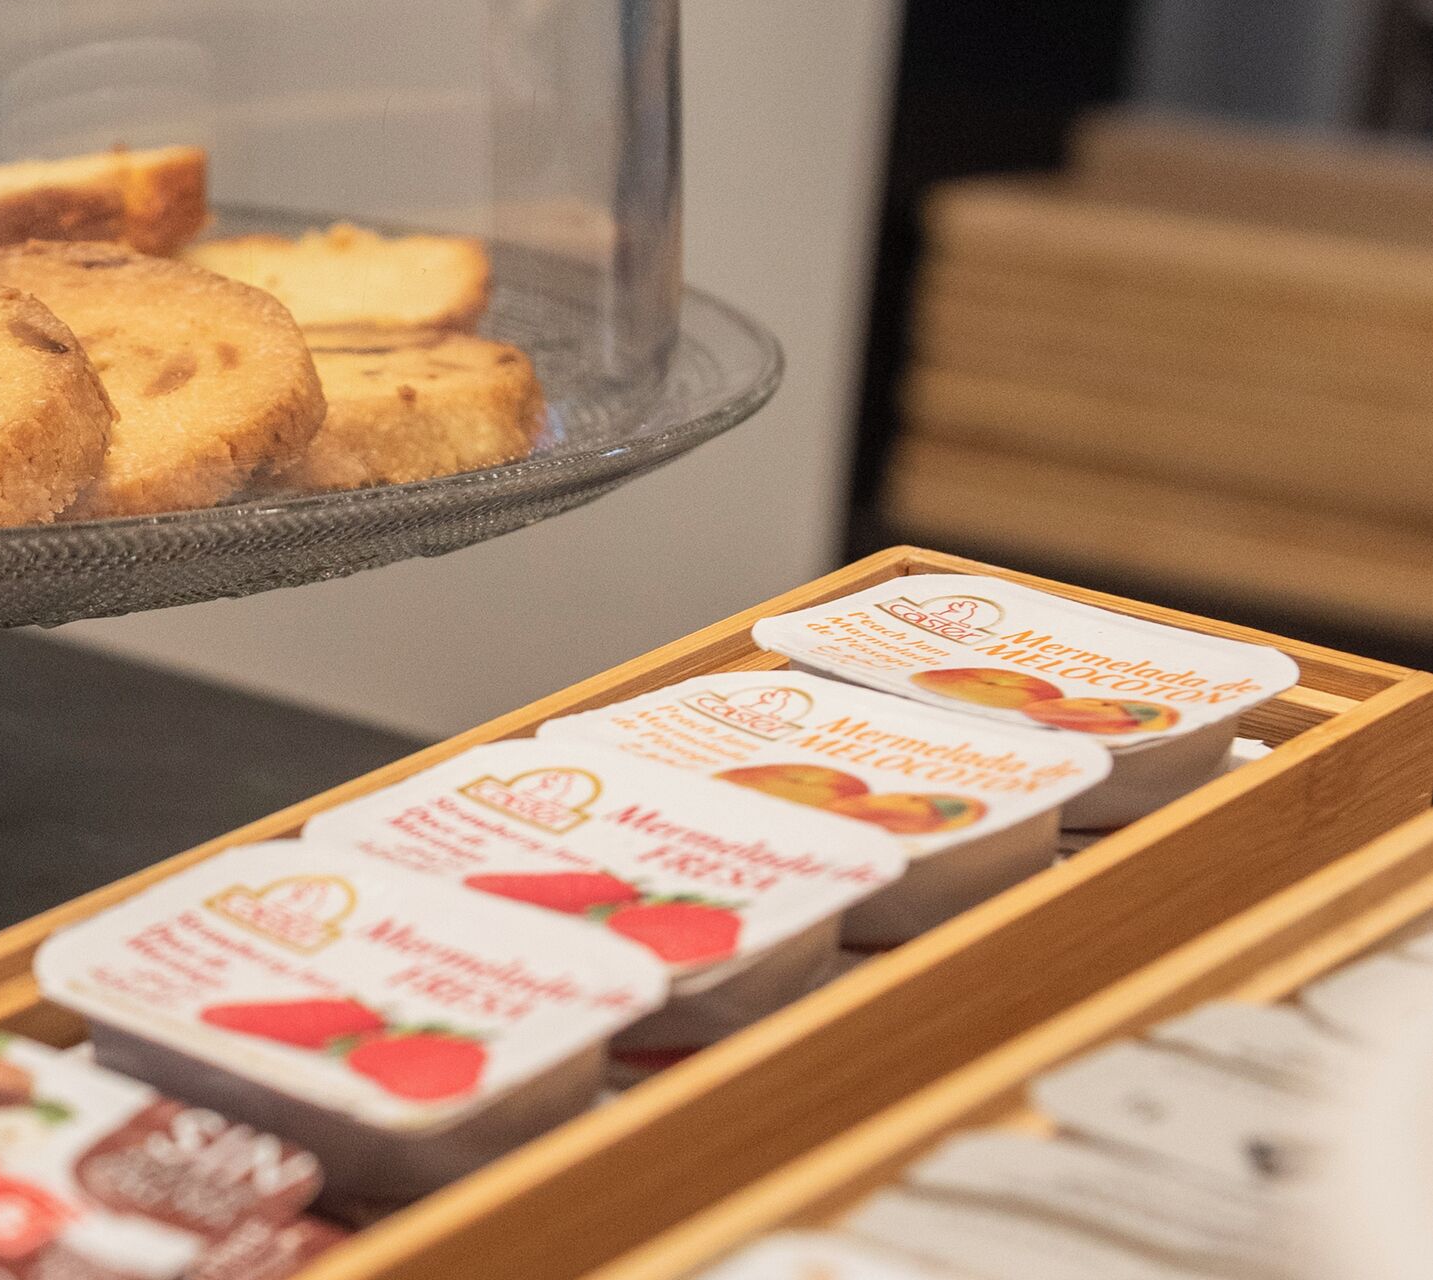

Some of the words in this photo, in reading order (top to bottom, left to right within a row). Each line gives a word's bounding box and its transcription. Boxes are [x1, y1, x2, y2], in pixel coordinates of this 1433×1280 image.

[807, 623, 834, 636] de
[824, 616, 943, 666] Marmelada
[847, 611, 908, 640] Peach
[905, 639, 952, 658] Jam
[1000, 629, 1208, 688] Mermelada
[1210, 677, 1262, 694] de
[816, 716, 1028, 772] Mermelada
